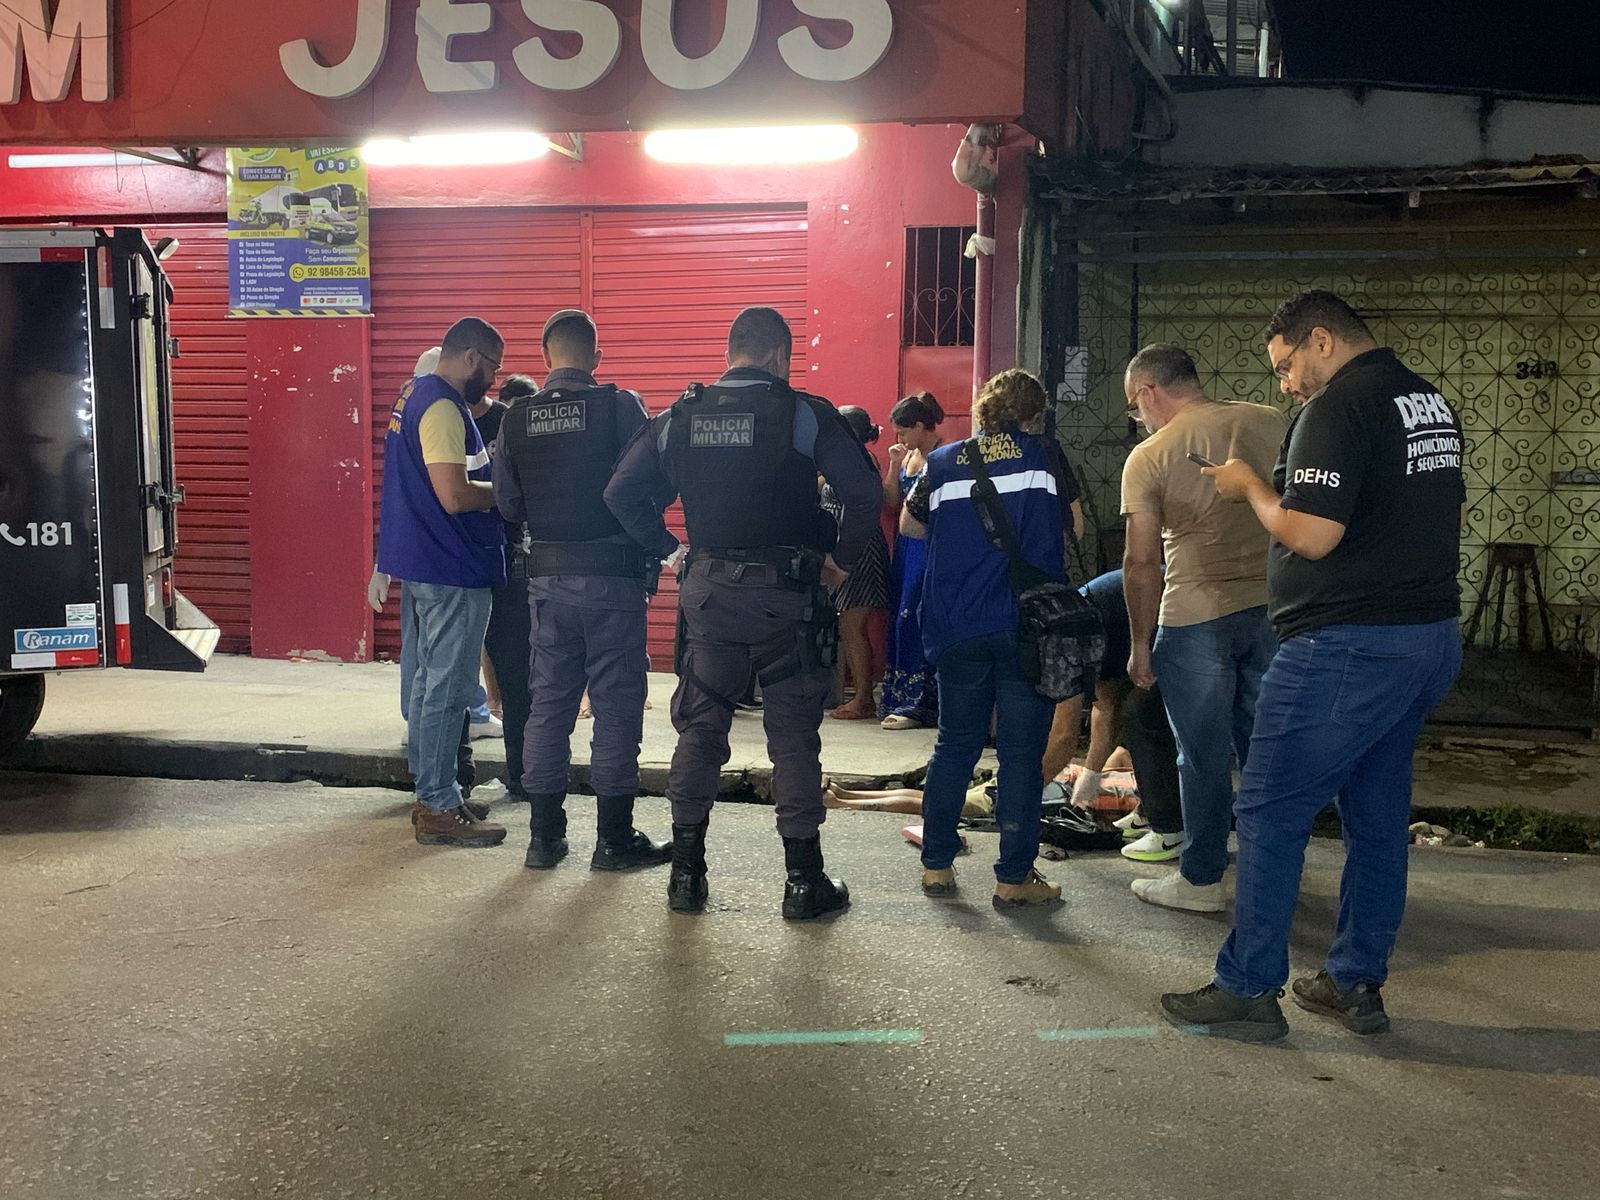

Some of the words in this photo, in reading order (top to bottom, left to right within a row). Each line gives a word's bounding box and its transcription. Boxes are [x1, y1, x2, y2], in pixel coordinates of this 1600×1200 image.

[279, 0, 896, 98] JESUS
[317, 162, 324, 171] A
[328, 160, 335, 169] B
[338, 162, 345, 171] D
[350, 159, 357, 168] E
[307, 267, 318, 277] 92
[531, 404, 582, 421] POLÍCIA
[1394, 392, 1454, 430] DEHS
[531, 417, 582, 434] MILITAR
[694, 416, 751, 432] POLÍCIA
[692, 431, 751, 446] MILITAR
[977, 433, 1013, 446] ERÍCIA
[1406, 460, 1415, 476] E
[1294, 467, 1341, 488] DEHS
[26, 521, 73, 546] 181
[23, 631, 90, 649] Ranam
